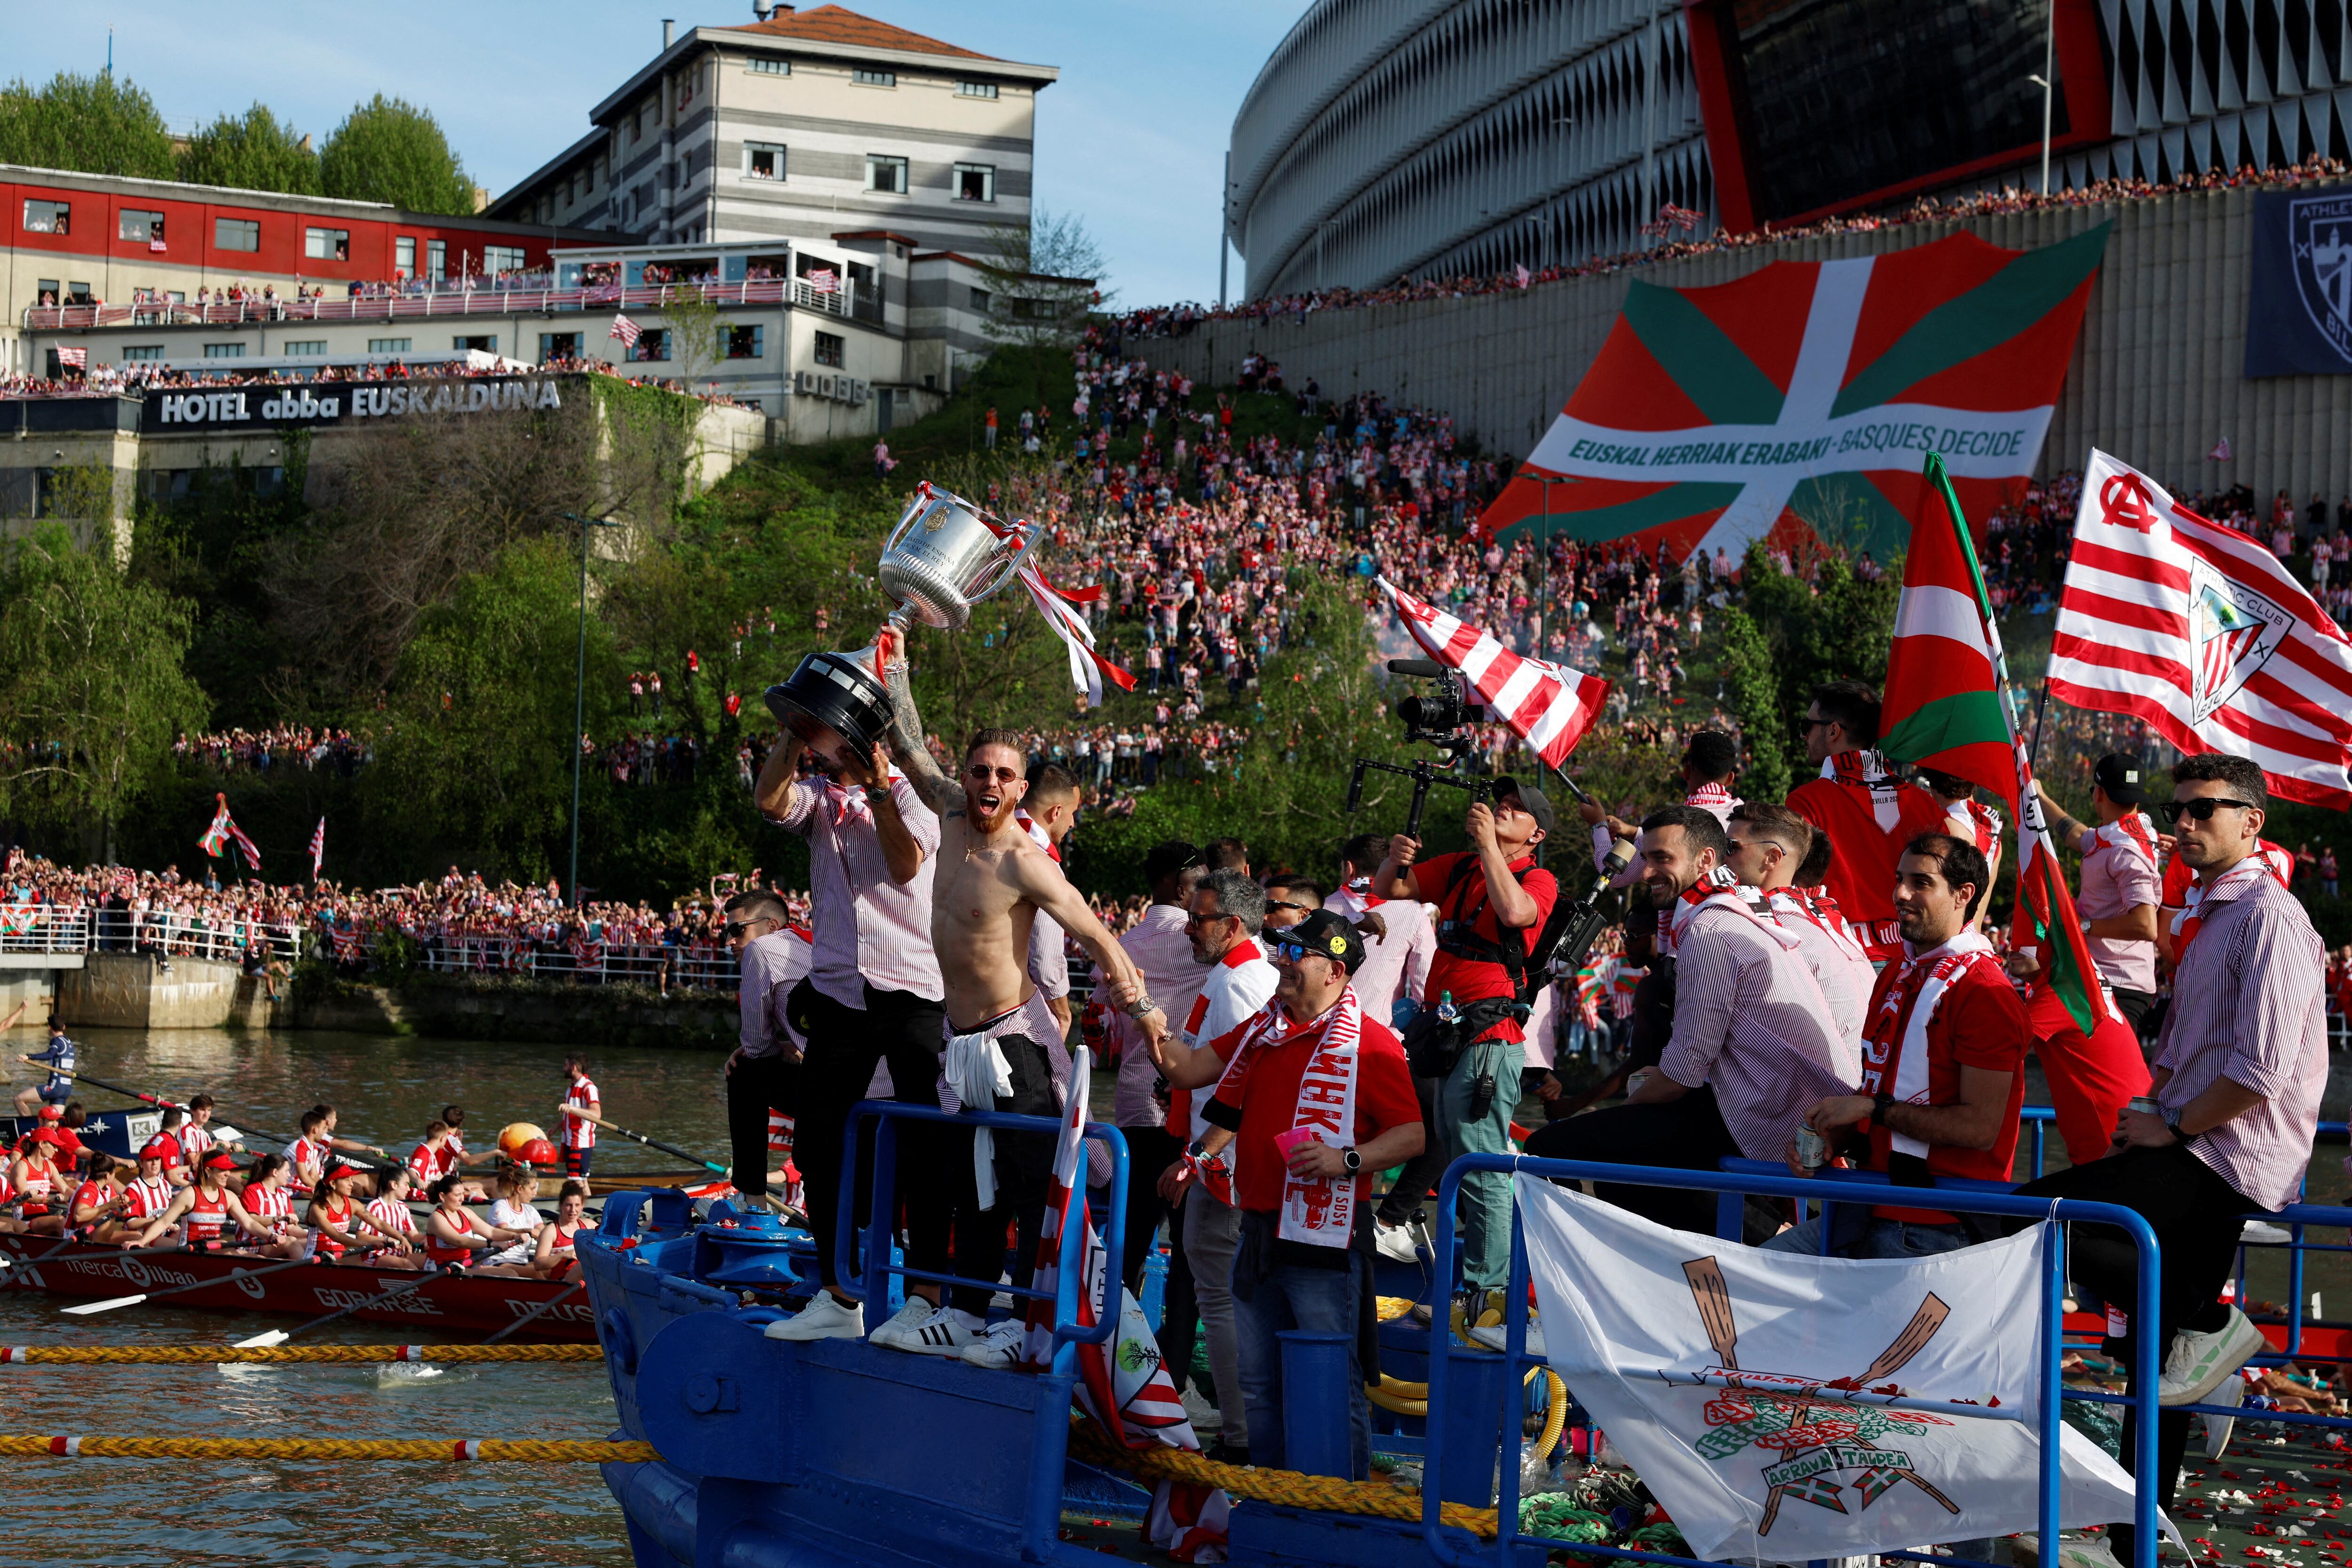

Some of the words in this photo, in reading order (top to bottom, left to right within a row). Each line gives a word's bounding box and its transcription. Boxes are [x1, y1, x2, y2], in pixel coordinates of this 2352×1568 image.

[161, 392, 250, 423] HOTEL
[262, 389, 340, 420] abba
[352, 380, 561, 417] EUSKALDUNA
[1568, 438, 1650, 466] EUSKAL
[1649, 441, 1743, 467] HERRIAK
[1739, 436, 1832, 465] ERABAKI
[1837, 422, 1935, 453] BASQUES
[1937, 429, 2025, 457] DECIDE
[931, 547, 955, 565] ESPAÑA
[931, 556, 946, 566] REY
[2199, 567, 2244, 604] ATHLETIC
[2247, 599, 2284, 626] CLUB
[1397, 1006, 1407, 1015] eitb
[1769, 1452, 1832, 1486] ARRAUN
[1841, 1450, 1908, 1468] TALDEA
